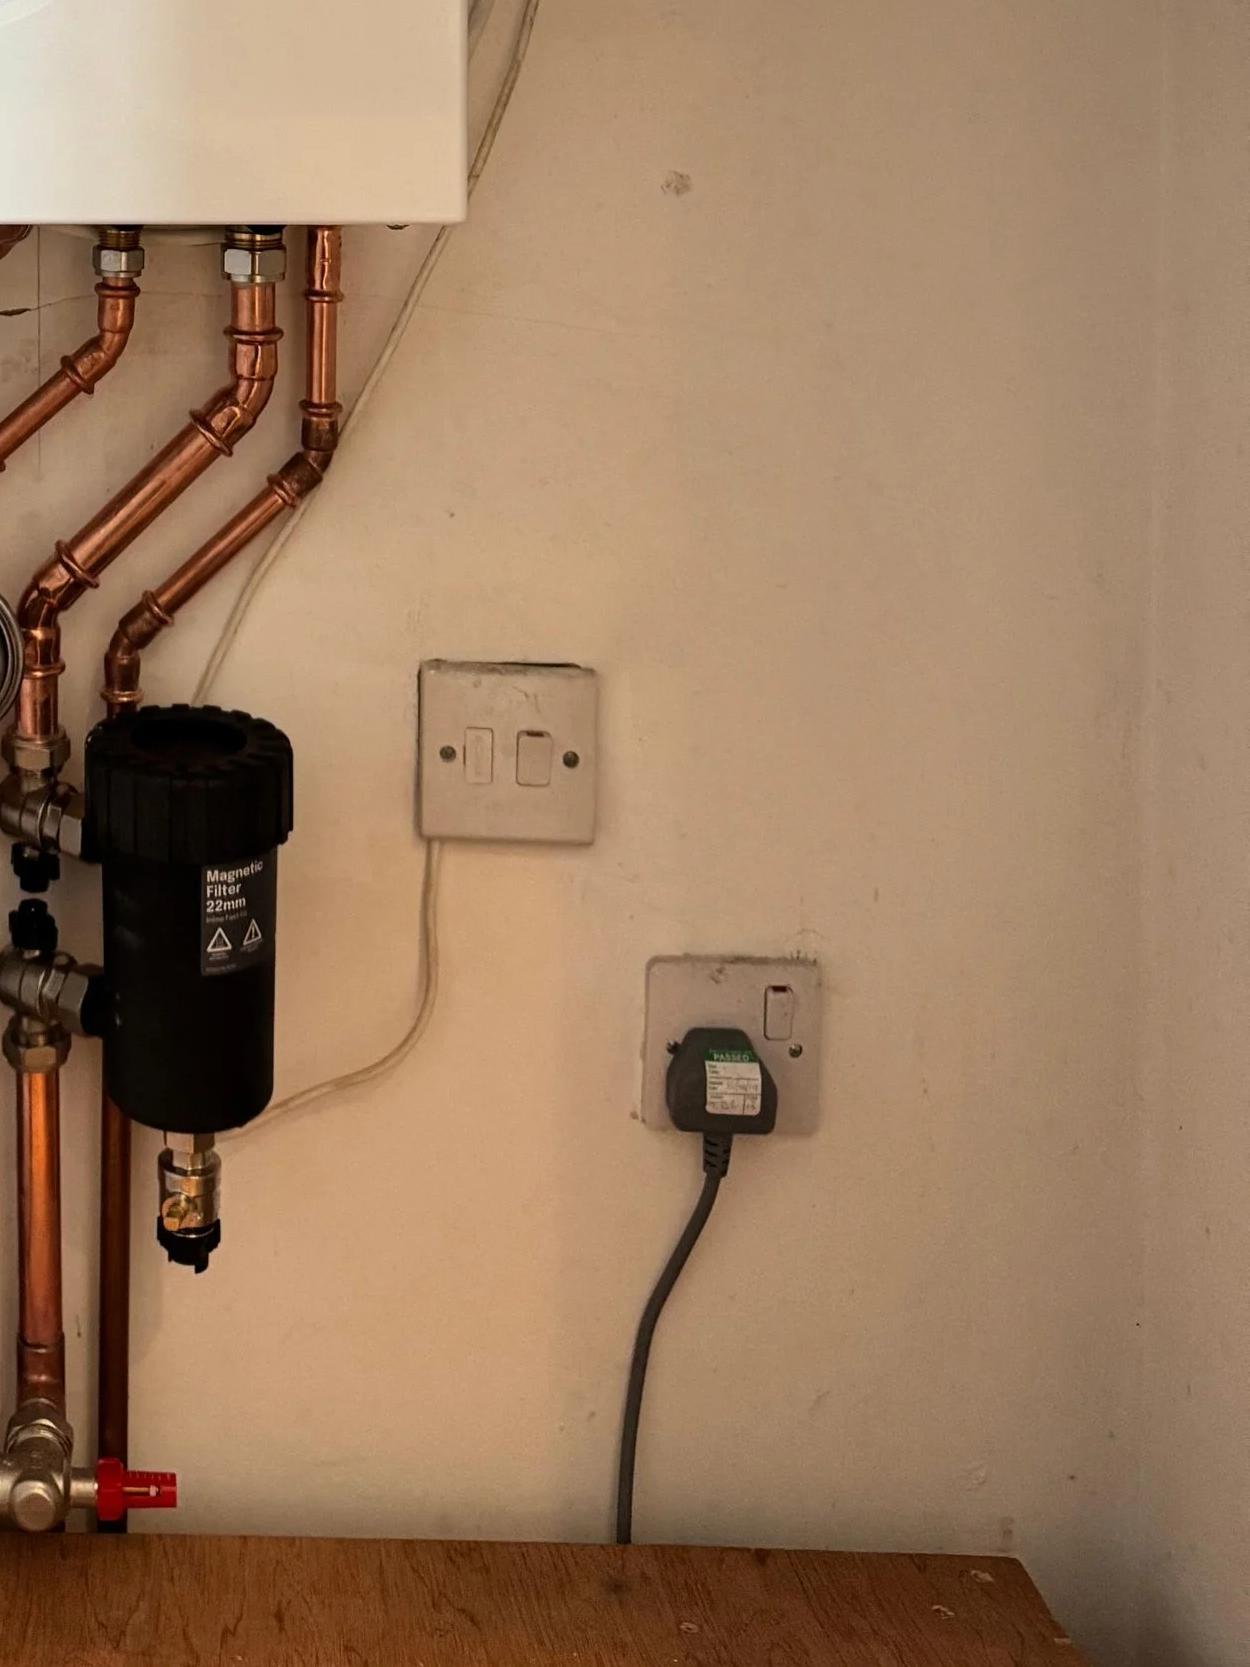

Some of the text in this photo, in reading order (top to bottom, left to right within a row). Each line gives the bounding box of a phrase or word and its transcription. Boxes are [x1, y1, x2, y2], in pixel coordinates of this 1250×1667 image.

[206, 860, 264, 883] Magnetic
[206, 883, 242, 898] Filter
[206, 897, 246, 913] 22mm
